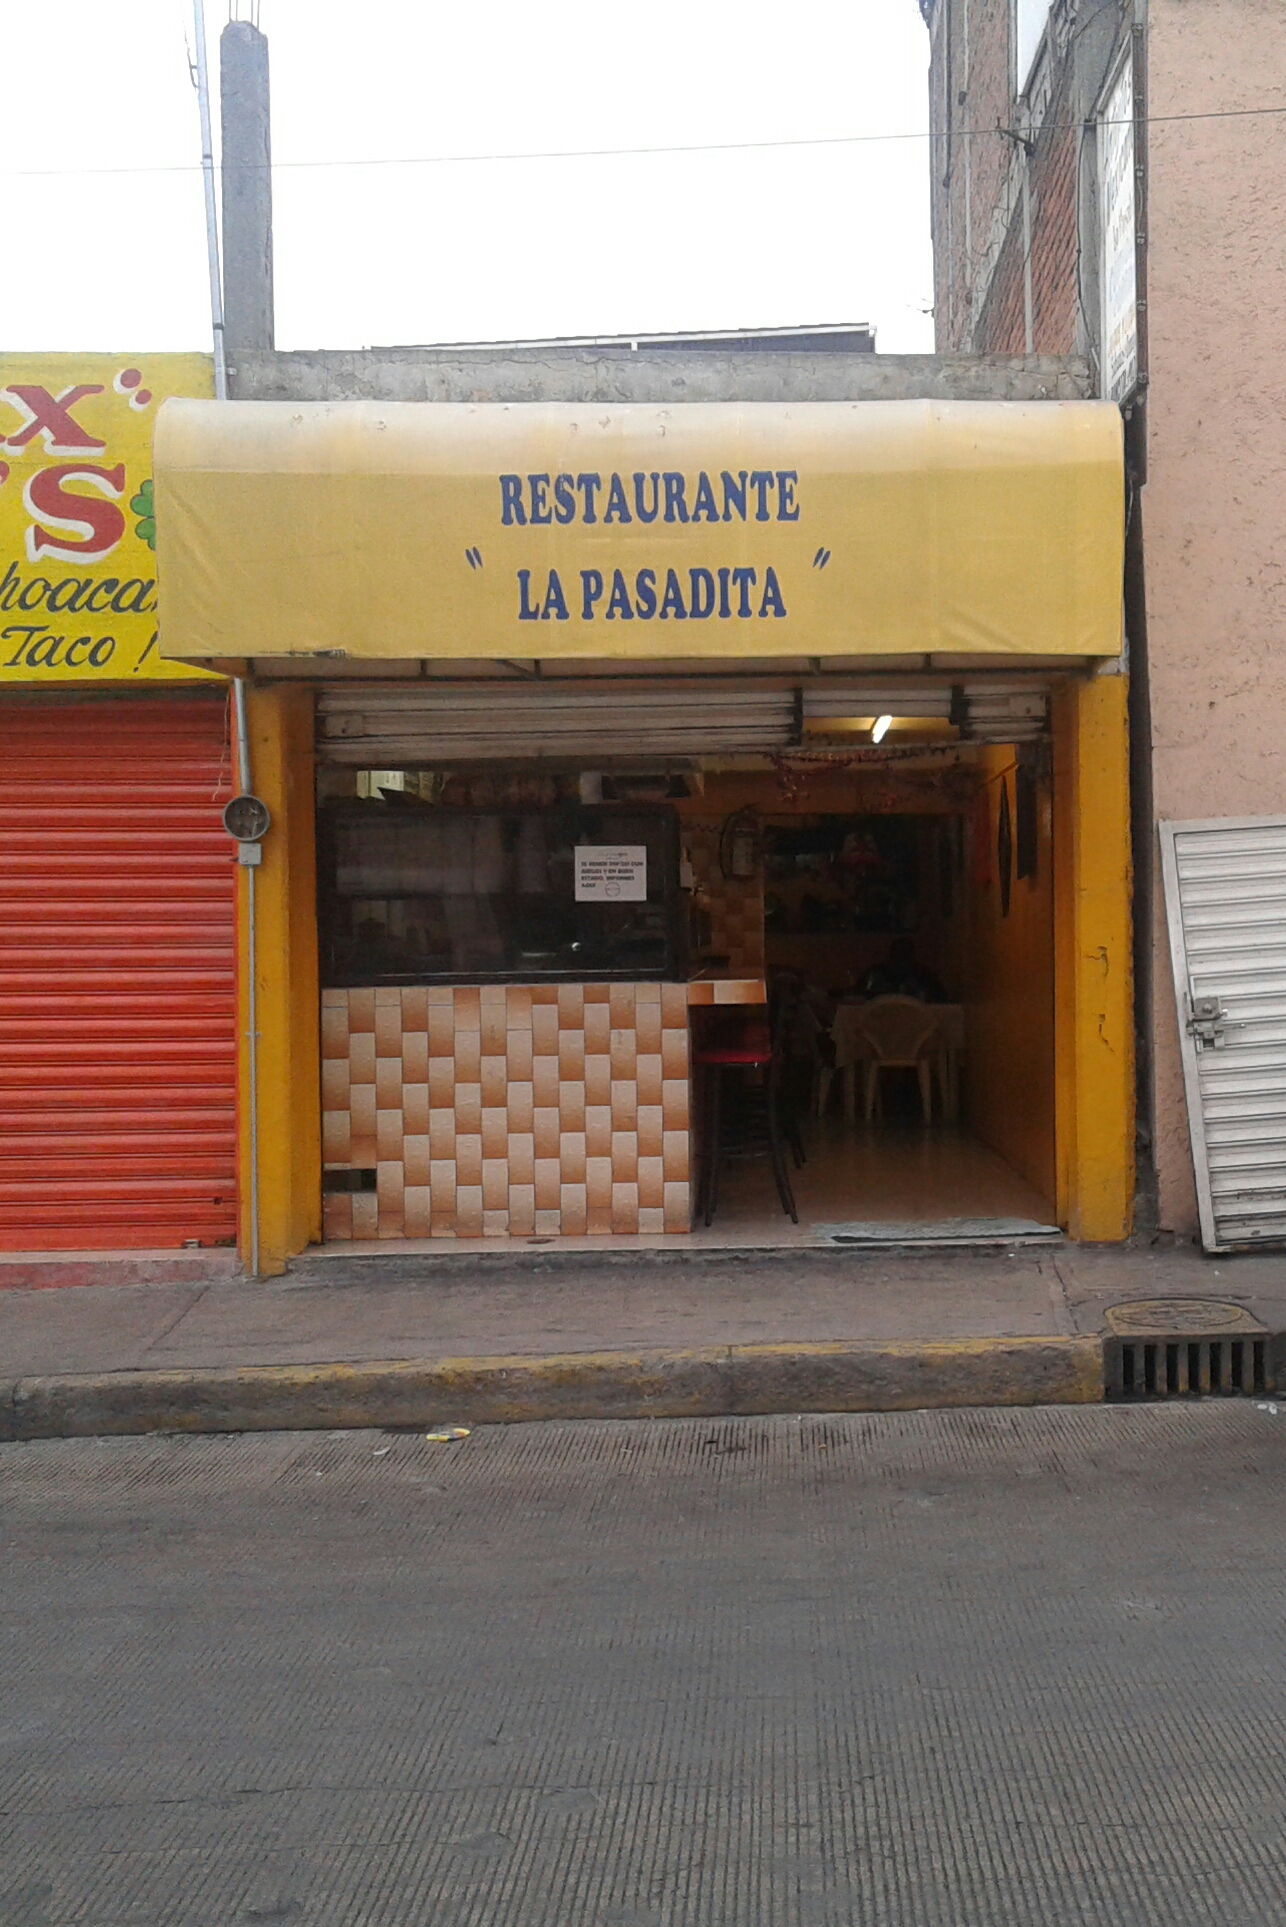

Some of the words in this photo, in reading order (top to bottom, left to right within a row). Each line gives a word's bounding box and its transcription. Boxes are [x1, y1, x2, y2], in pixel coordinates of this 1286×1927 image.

[0, 384, 106, 456] X
[499, 470, 801, 526] RESTAURANTE
[0, 561, 158, 613] hoaca
[517, 568, 570, 621] LA
[580, 566, 787, 620] PASADITA
[0, 625, 116, 668] Taco
